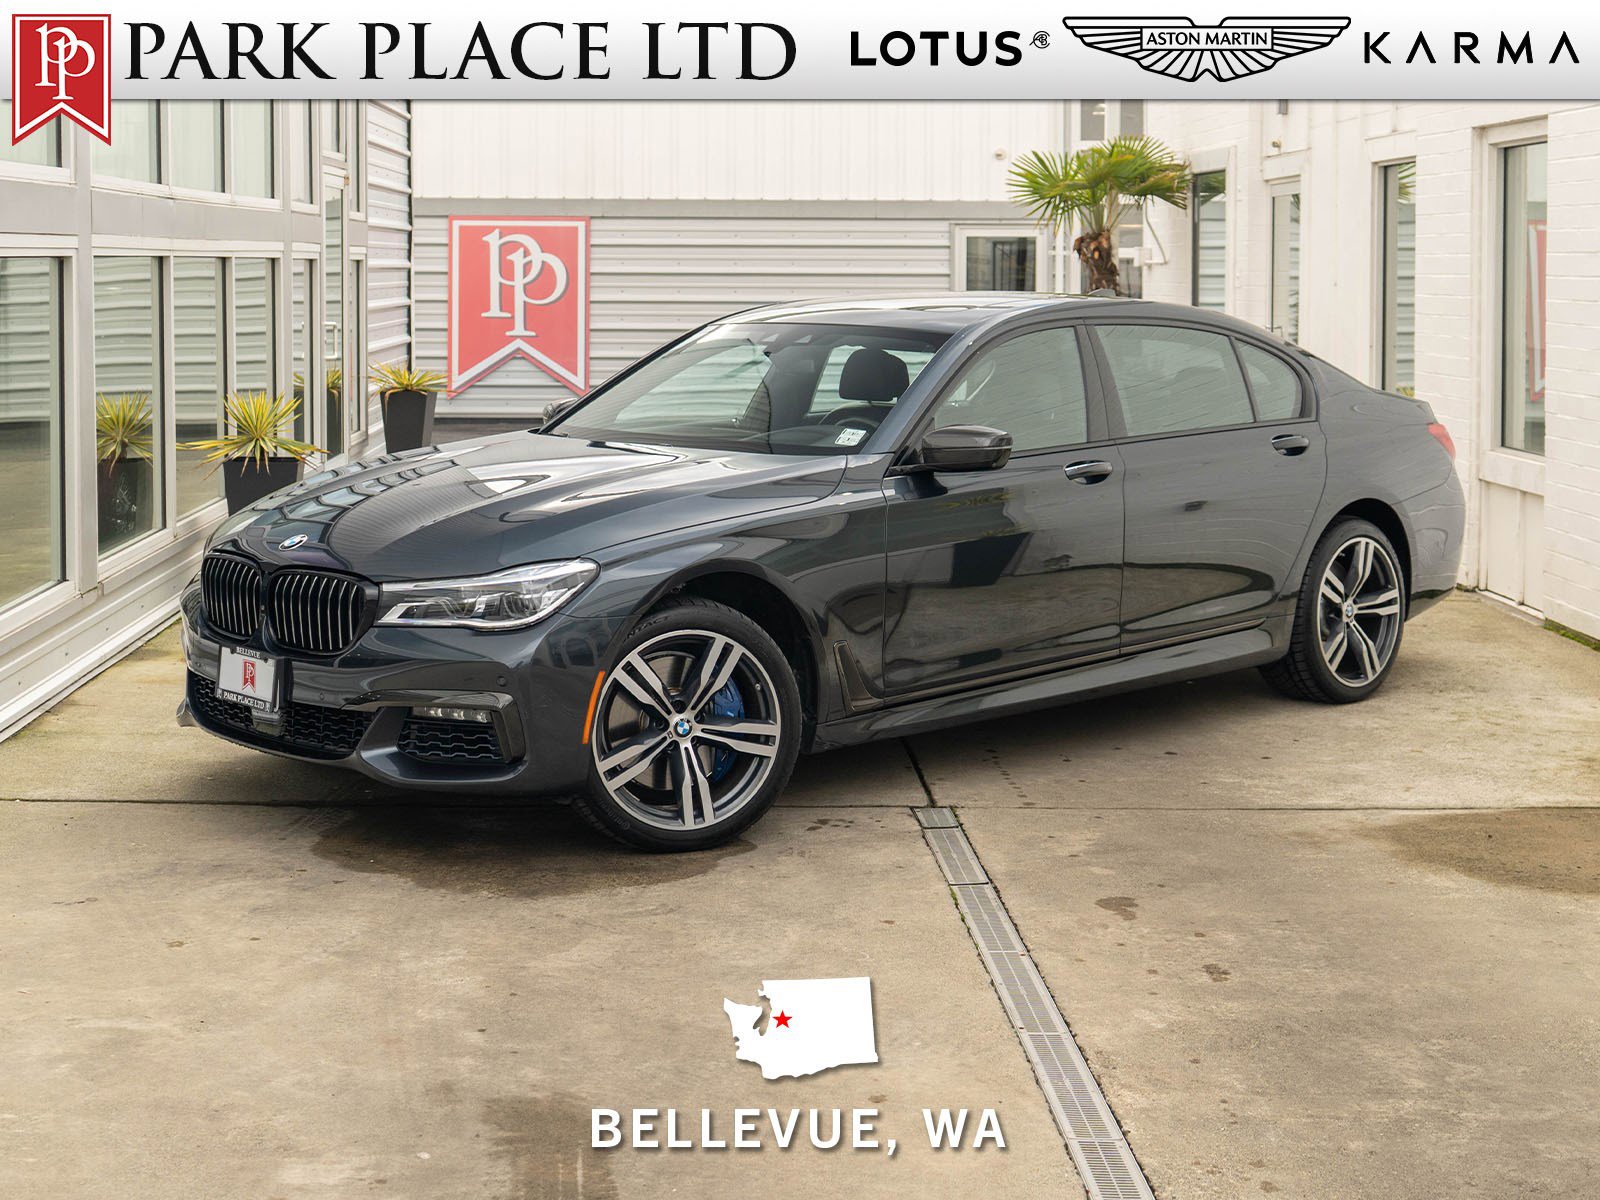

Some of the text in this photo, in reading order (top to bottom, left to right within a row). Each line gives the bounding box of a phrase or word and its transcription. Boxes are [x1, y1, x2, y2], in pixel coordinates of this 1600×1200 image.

[236, 646, 261, 658] BELLEVUE
[223, 691, 238, 701] PARK
[237, 695, 254, 707] PLACE
[254, 699, 265, 709] LTD
